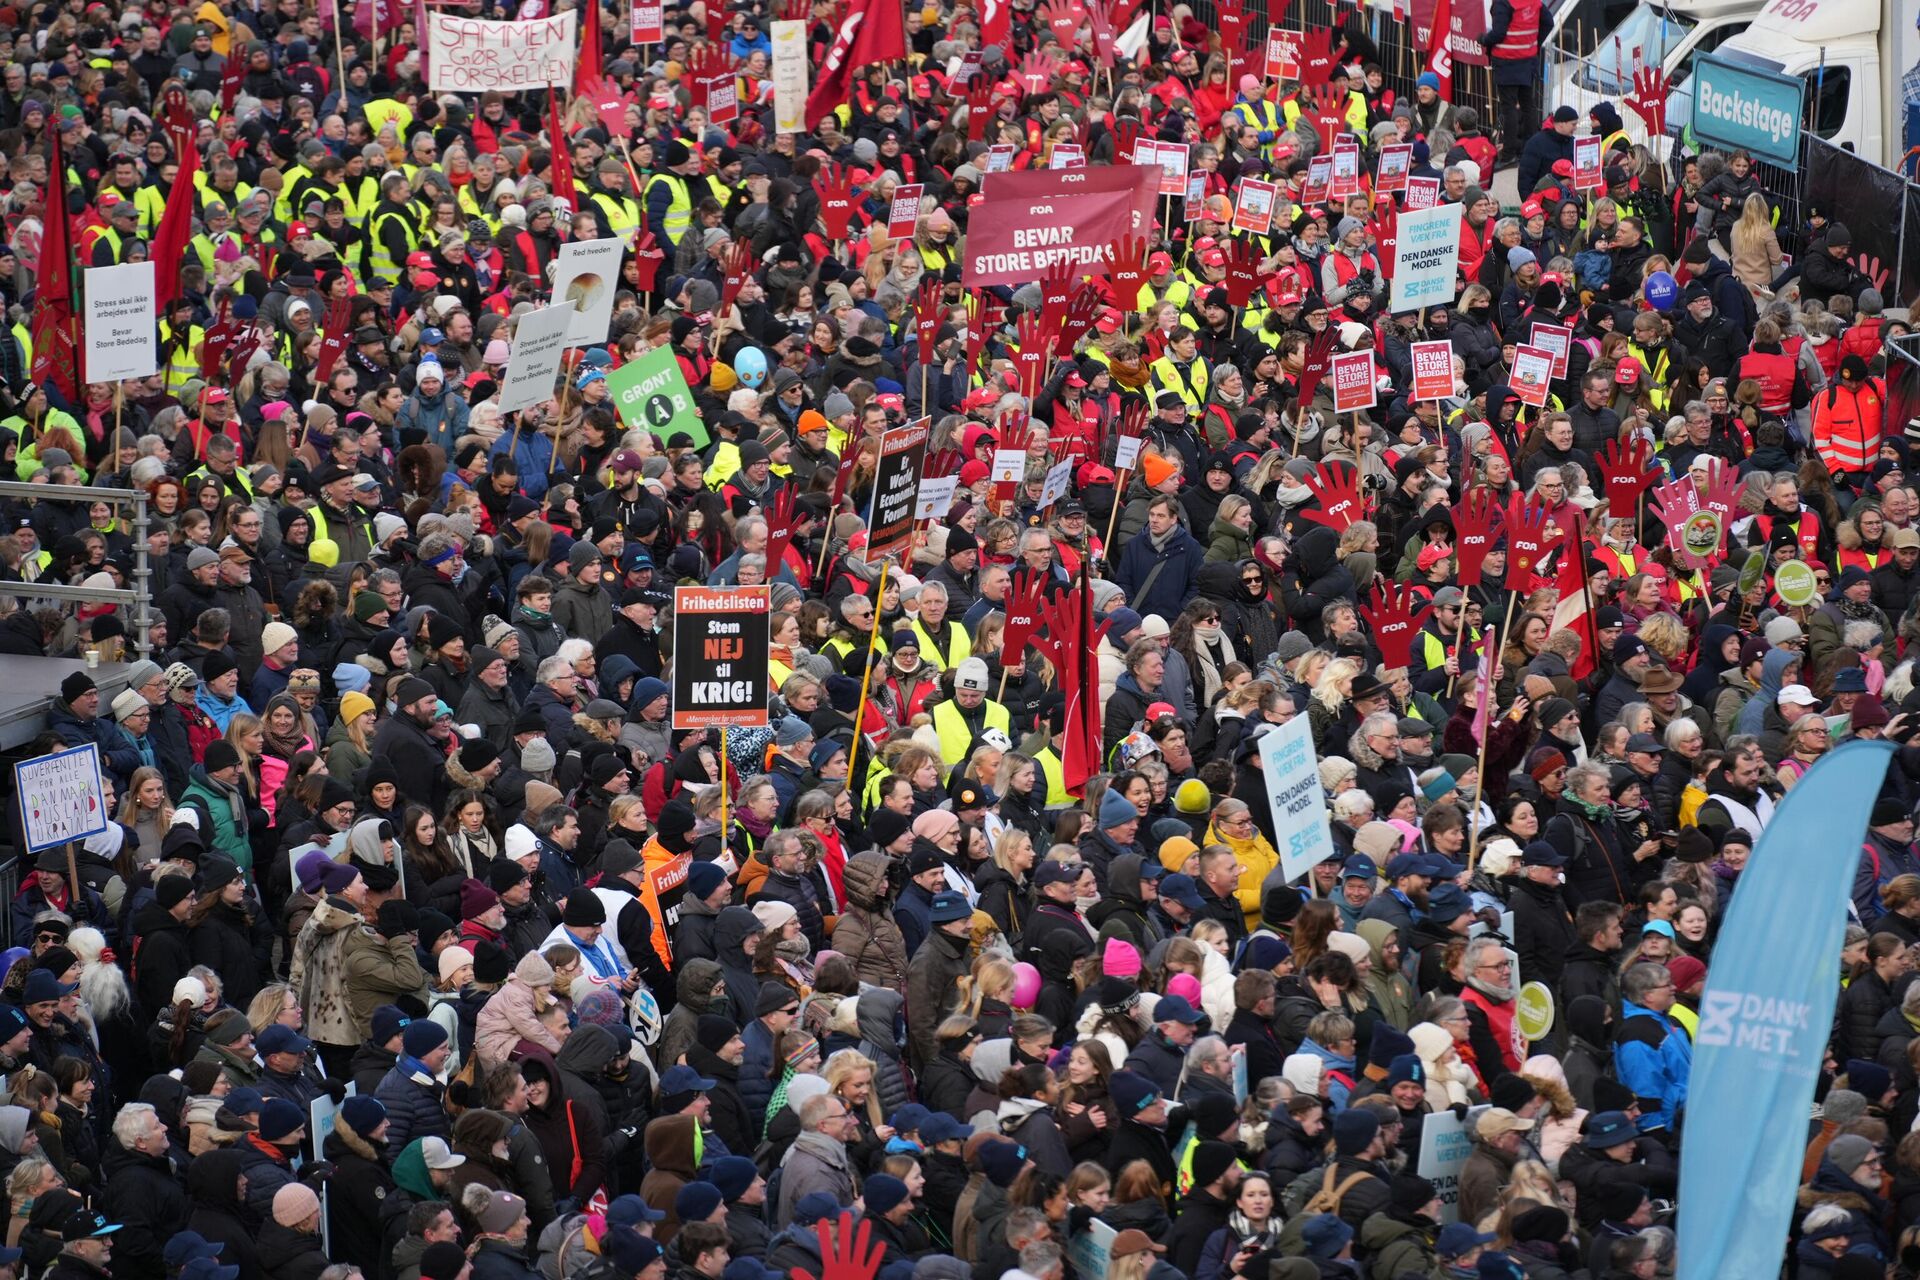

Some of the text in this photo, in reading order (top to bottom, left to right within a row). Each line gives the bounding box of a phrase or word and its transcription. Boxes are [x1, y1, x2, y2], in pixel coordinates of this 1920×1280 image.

[633, 7, 659, 16] BEVAR
[1769, 0, 1818, 22] FOA
[633, 15, 660, 24] STORE
[440, 18, 565, 48] SAMMEN
[449, 46, 538, 66] GØR VI
[1310, 58, 1328, 67] FOA
[439, 60, 570, 87] FORSKELLEN
[710, 85, 735, 99] BEVAR
[710, 93, 736, 105] STORE
[1643, 99, 1660, 108] FOA
[1700, 79, 1793, 144] Backstage
[1061, 174, 1085, 182] FOA
[1410, 186, 1436, 195] BEVAR
[827, 200, 848, 208] FOA
[894, 197, 918, 208] BEVAR
[1408, 194, 1435, 202] STORE
[893, 206, 917, 216] STORE
[1030, 205, 1053, 215] FOA
[1409, 218, 1452, 234] FINGRENE
[1014, 226, 1074, 248] BEVAR
[1411, 230, 1447, 243] VÆK FRA
[573, 246, 611, 257] Red hveden
[1402, 245, 1454, 262] DEN DANSKE
[975, 244, 1115, 274] STORE BEDEDAG
[1411, 259, 1442, 271] MODEL
[1232, 270, 1252, 280] FOA
[1421, 277, 1445, 287] DANSK
[1420, 285, 1444, 295] METAL
[1651, 287, 1671, 295] BEVAR
[94, 296, 148, 309] Stress skal ikke
[1048, 295, 1066, 304] FOA
[96, 306, 146, 319] arbejdes væk!
[921, 321, 934, 329] FOA
[112, 328, 132, 337] Bevar
[969, 331, 980, 341] FOA
[95, 336, 147, 349] Store Bededag
[209, 334, 226, 344] FOA
[519, 338, 538, 349] Stress
[1022, 353, 1040, 361] FOA
[1416, 351, 1448, 362] BEVAR
[526, 362, 543, 372] Bevar
[1307, 363, 1322, 371] FOA
[1337, 362, 1369, 376] BEVAR
[1417, 360, 1449, 371] STORE
[511, 368, 553, 384] Store Bededag
[1338, 371, 1369, 384] STORE
[1417, 369, 1449, 378] BEDEDAG
[622, 368, 673, 404] GRØNT
[1338, 379, 1369, 390] BEDEDAG
[631, 393, 687, 431] HÅB
[884, 428, 927, 453] Frihedslisten
[901, 455, 910, 471] Er
[889, 467, 914, 490] World
[879, 482, 917, 509] Economic
[1328, 500, 1351, 515] FOA
[1708, 501, 1728, 513] FOA
[883, 504, 909, 525] Forum
[1674, 523, 1686, 532] FO
[1463, 536, 1485, 544] FOA
[1515, 540, 1537, 551] FOA
[682, 595, 764, 610] Frihedslisten
[1011, 616, 1031, 625] FOA
[708, 620, 740, 634] Stem
[1382, 621, 1407, 634] FOA
[704, 638, 744, 660] NEJ
[716, 663, 731, 677] til
[692, 680, 753, 704] KRIG!
[1272, 735, 1306, 766] FINGRENE
[40, 770, 80, 789] FOR ALLE
[1275, 773, 1317, 808] DEN DANSKE
[1287, 795, 1312, 818] MODEL
[37, 814, 94, 842] UKRAINE
